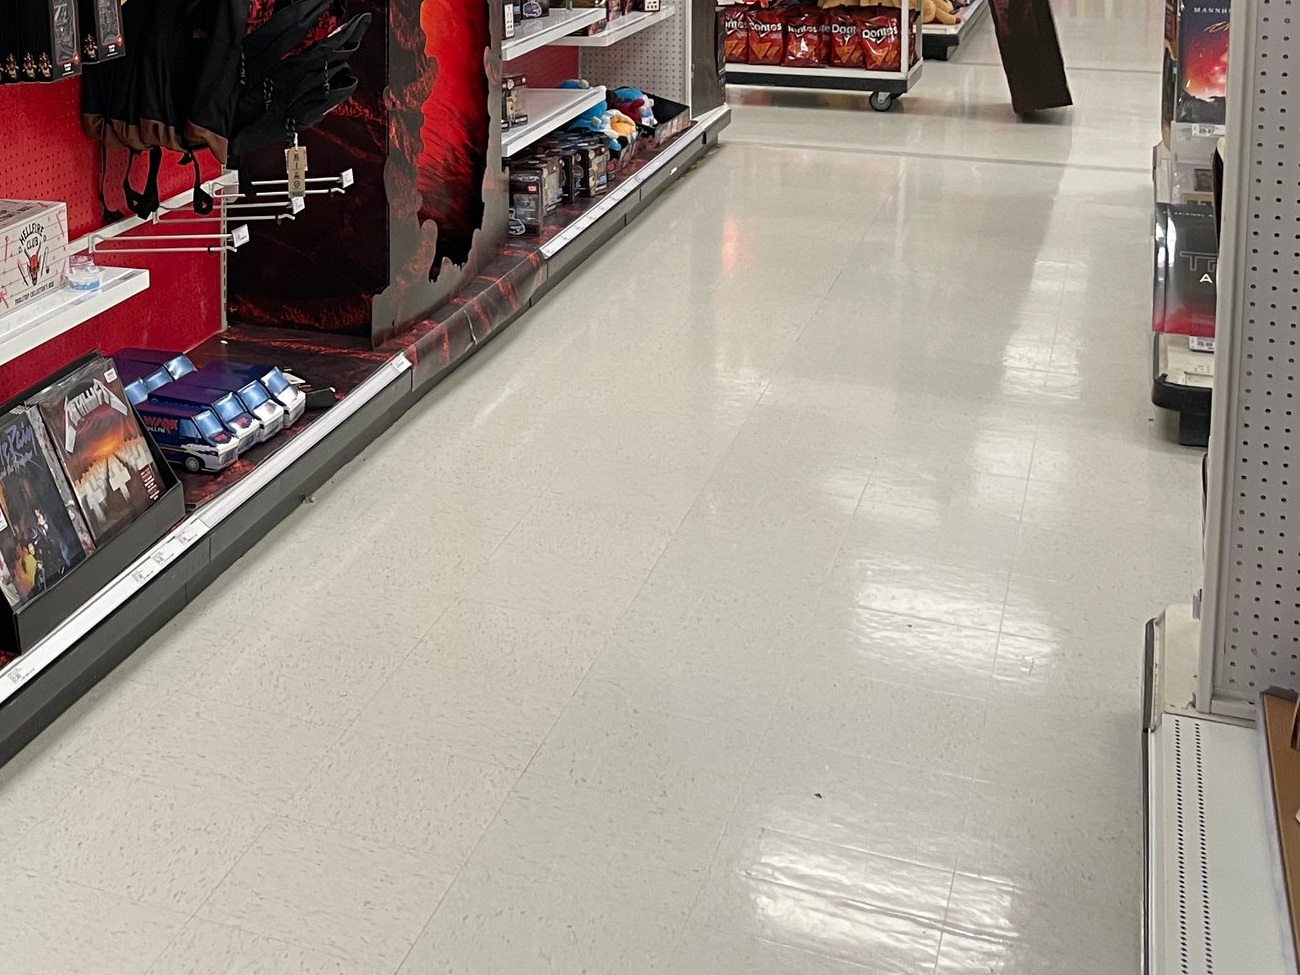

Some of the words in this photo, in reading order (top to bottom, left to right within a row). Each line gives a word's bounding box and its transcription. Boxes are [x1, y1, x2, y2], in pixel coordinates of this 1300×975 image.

[832, 23, 856, 34] Dorit
[862, 25, 898, 39] Doritos
[19, 223, 45, 245] HELLFIRE
[26, 236, 39, 250] CLUB
[64, 378, 128, 454] METALLICA
[5, 422, 38, 457] Rain
